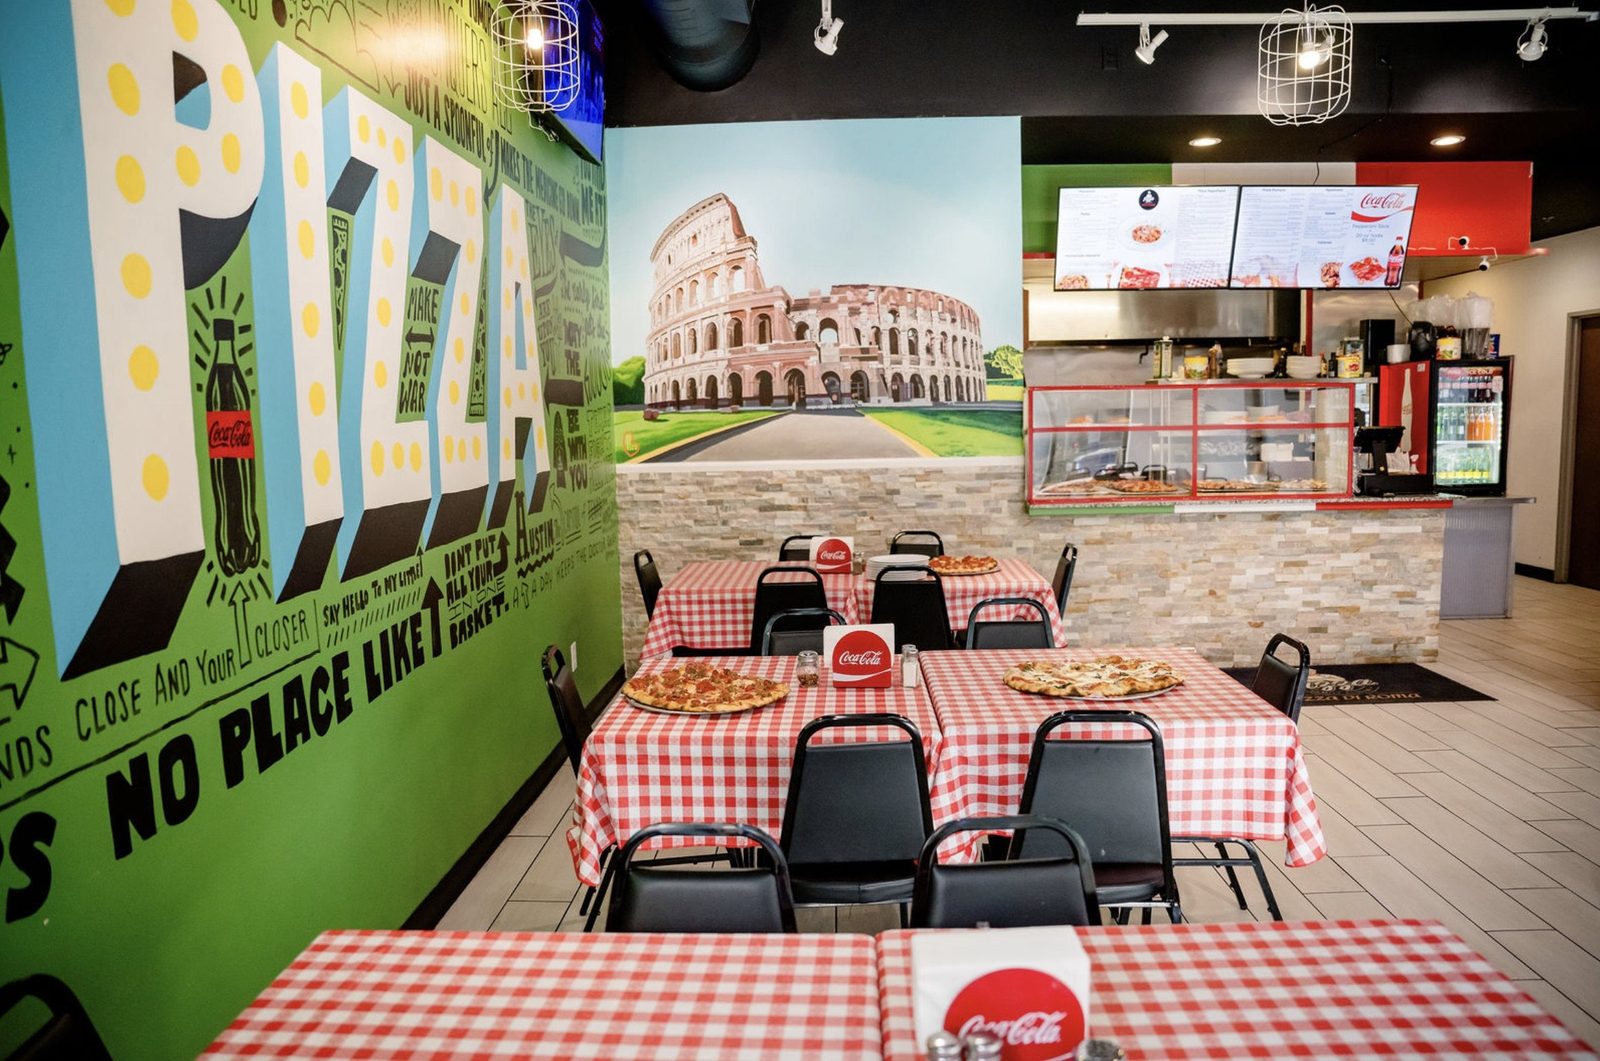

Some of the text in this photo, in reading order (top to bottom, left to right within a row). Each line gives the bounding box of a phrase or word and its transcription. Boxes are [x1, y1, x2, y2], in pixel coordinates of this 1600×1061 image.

[404, 64, 430, 124] JUST
[433, 84, 442, 132] A
[444, 93, 487, 164] SPOONFUL
[500, 136, 520, 185] MAKES
[521, 153, 534, 194] THE
[72, 0, 551, 566] PIZZA
[407, 286, 440, 325] MAKE
[402, 350, 431, 378] NOT
[564, 348, 581, 377] THE
[399, 378, 426, 414] WAR
[566, 408, 580, 434] BE
[568, 463, 588, 492] YOU
[514, 490, 555, 566] AUSTIN
[444, 534, 496, 580] DONT PUT
[322, 602, 341, 628] SAY
[342, 589, 370, 619] HELLO
[384, 574, 398, 596] MY
[446, 560, 494, 608] ALL YOUR
[449, 575, 506, 622] IN ONE
[449, 591, 510, 651] BASKET.
[75, 678, 142, 742] CLOSE
[155, 658, 191, 706] AND
[196, 648, 238, 686] YOUR
[254, 608, 310, 659] CLOSER
[839, 650, 882, 665] Coca-Cola
[0, 610, 425, 924] S NO PLACE LIKE
